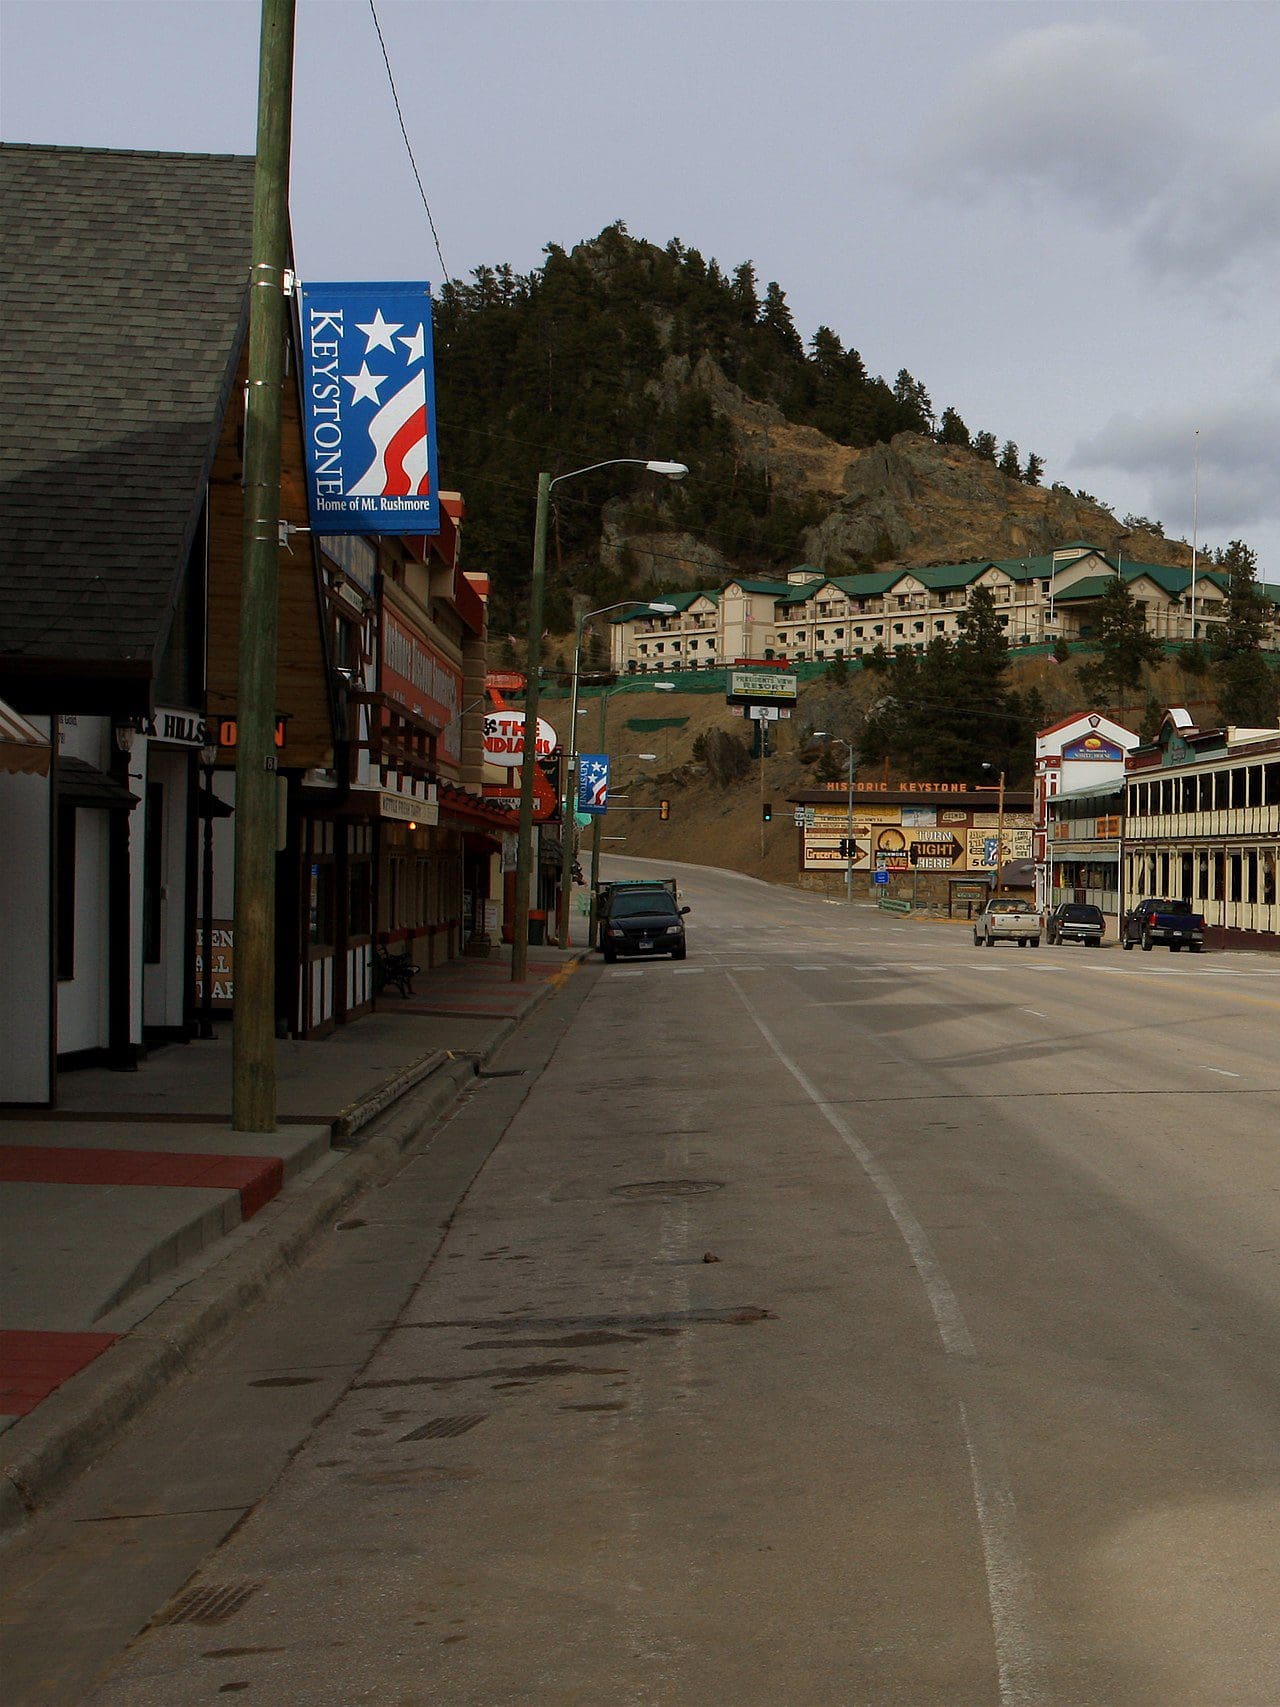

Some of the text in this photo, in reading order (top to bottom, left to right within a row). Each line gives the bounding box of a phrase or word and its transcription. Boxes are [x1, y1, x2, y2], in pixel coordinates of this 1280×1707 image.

[310, 308, 344, 496] KEYSTONE
[316, 497, 430, 511] Home of Mt. Rushmore
[744, 682, 784, 690] RESORT
[164, 714, 206, 743] HILLS
[900, 782, 967, 792] KEYSTONE
[917, 831, 952, 841] TURN
[915, 843, 955, 855] RIGHT
[916, 857, 950, 868] HERE
